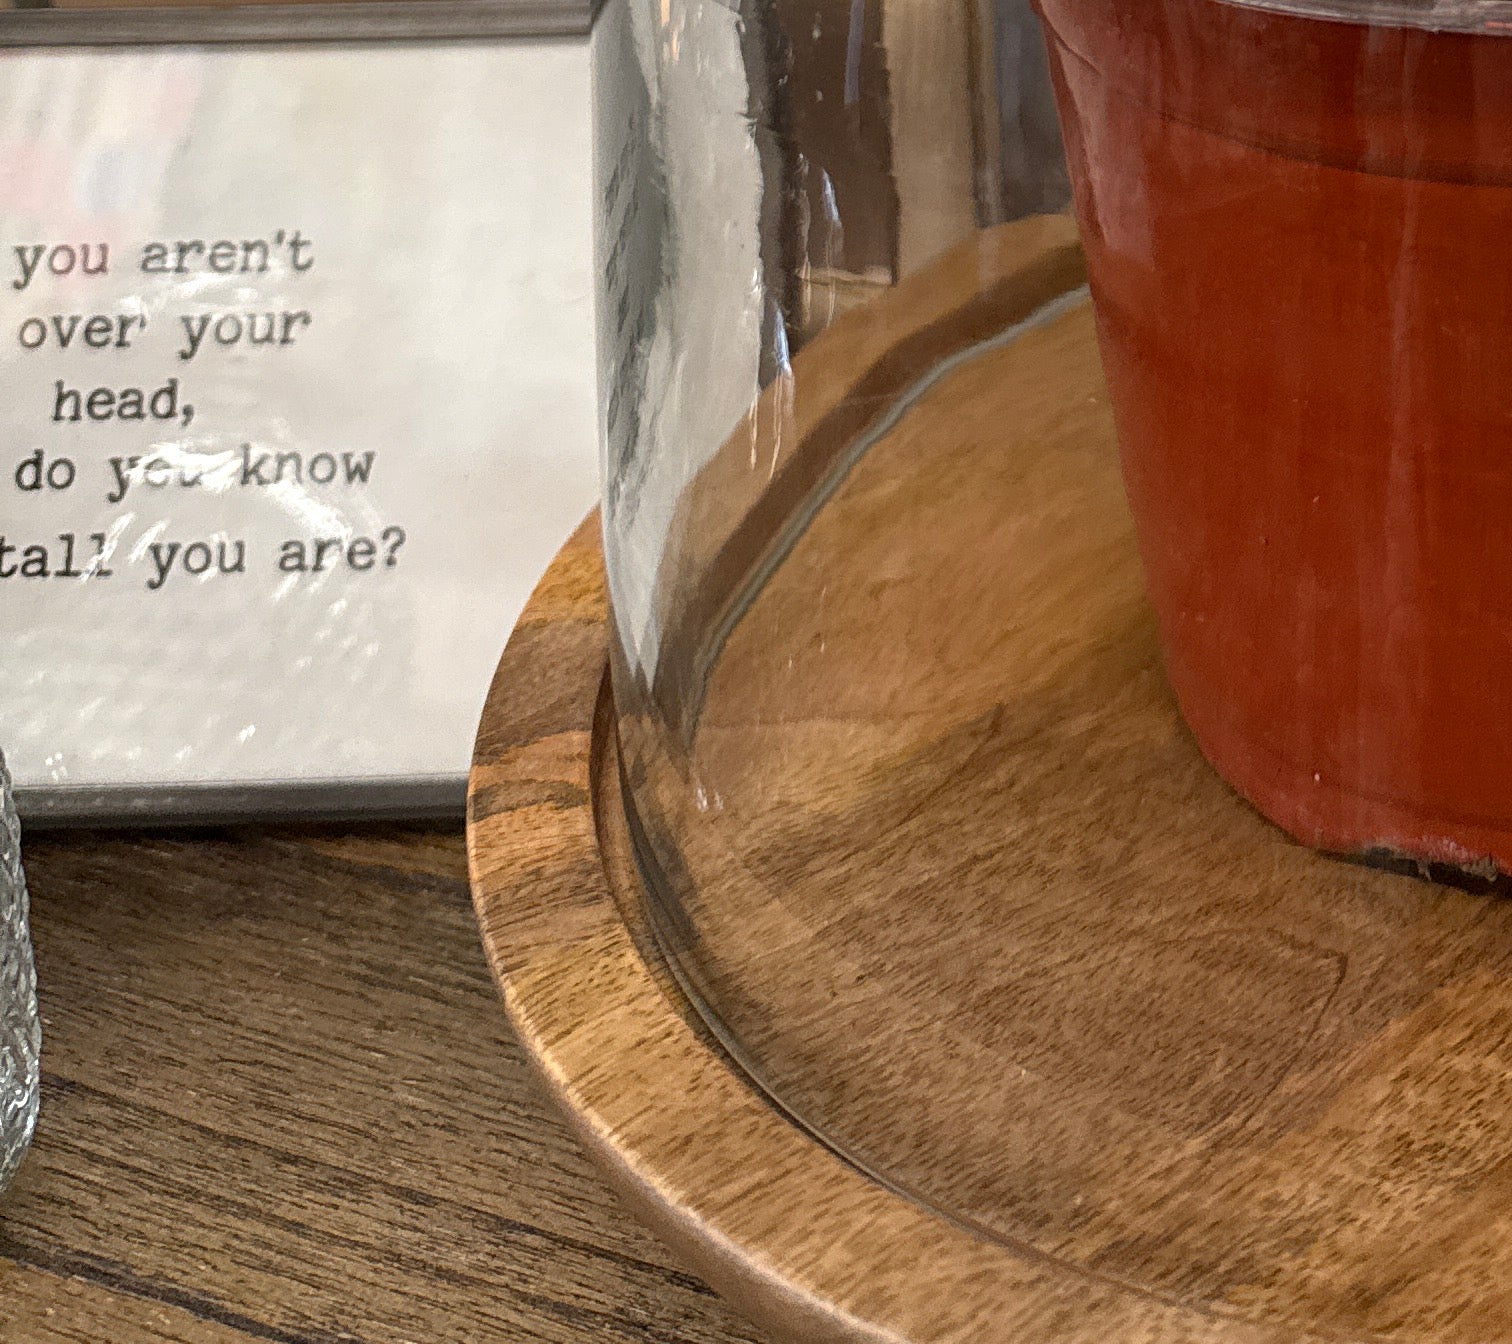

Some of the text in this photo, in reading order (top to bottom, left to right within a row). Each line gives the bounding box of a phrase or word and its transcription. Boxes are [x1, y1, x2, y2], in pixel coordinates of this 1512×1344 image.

[12, 229, 314, 290] you aren't
[19, 307, 313, 360] over your
[52, 378, 196, 426] head,
[14, 448, 77, 493] do
[240, 443, 377, 486] know
[146, 538, 246, 591] you
[278, 525, 408, 573] are?
